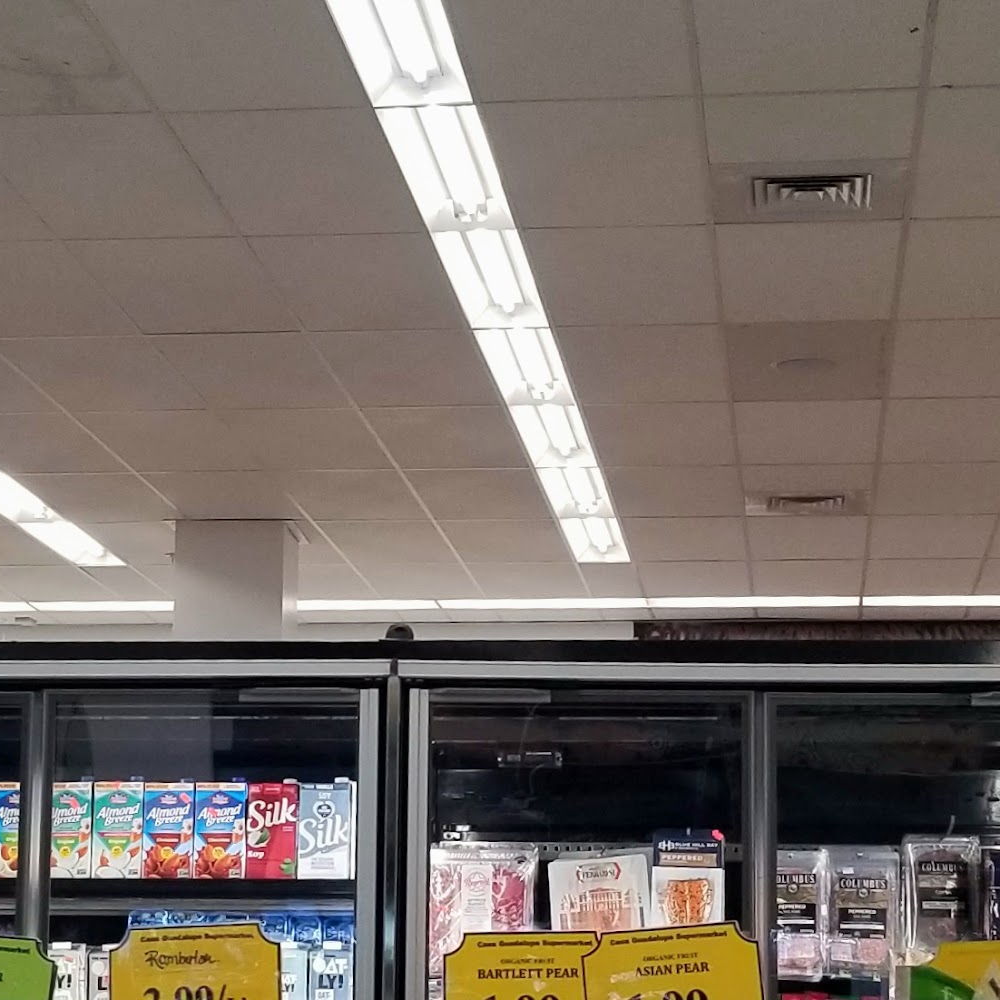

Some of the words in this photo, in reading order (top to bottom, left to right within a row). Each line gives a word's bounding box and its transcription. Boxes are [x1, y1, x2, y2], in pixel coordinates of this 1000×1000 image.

[96, 803, 140, 819] Almond
[146, 803, 190, 820] Almond
[247, 798, 297, 831] Silk
[206, 815, 234, 827] Breeze
[299, 814, 348, 855] Silk
[777, 874, 815, 884] OLUMBUS
[840, 878, 886, 889] COLUMBUS
[610, 938, 629, 946] Casa
[478, 968, 543, 979] BARTLETT
[546, 968, 579, 978] PEAR
[635, 964, 672, 977] ASIAN
[676, 961, 710, 974] PEAR
[318, 974, 344, 989] LY!
